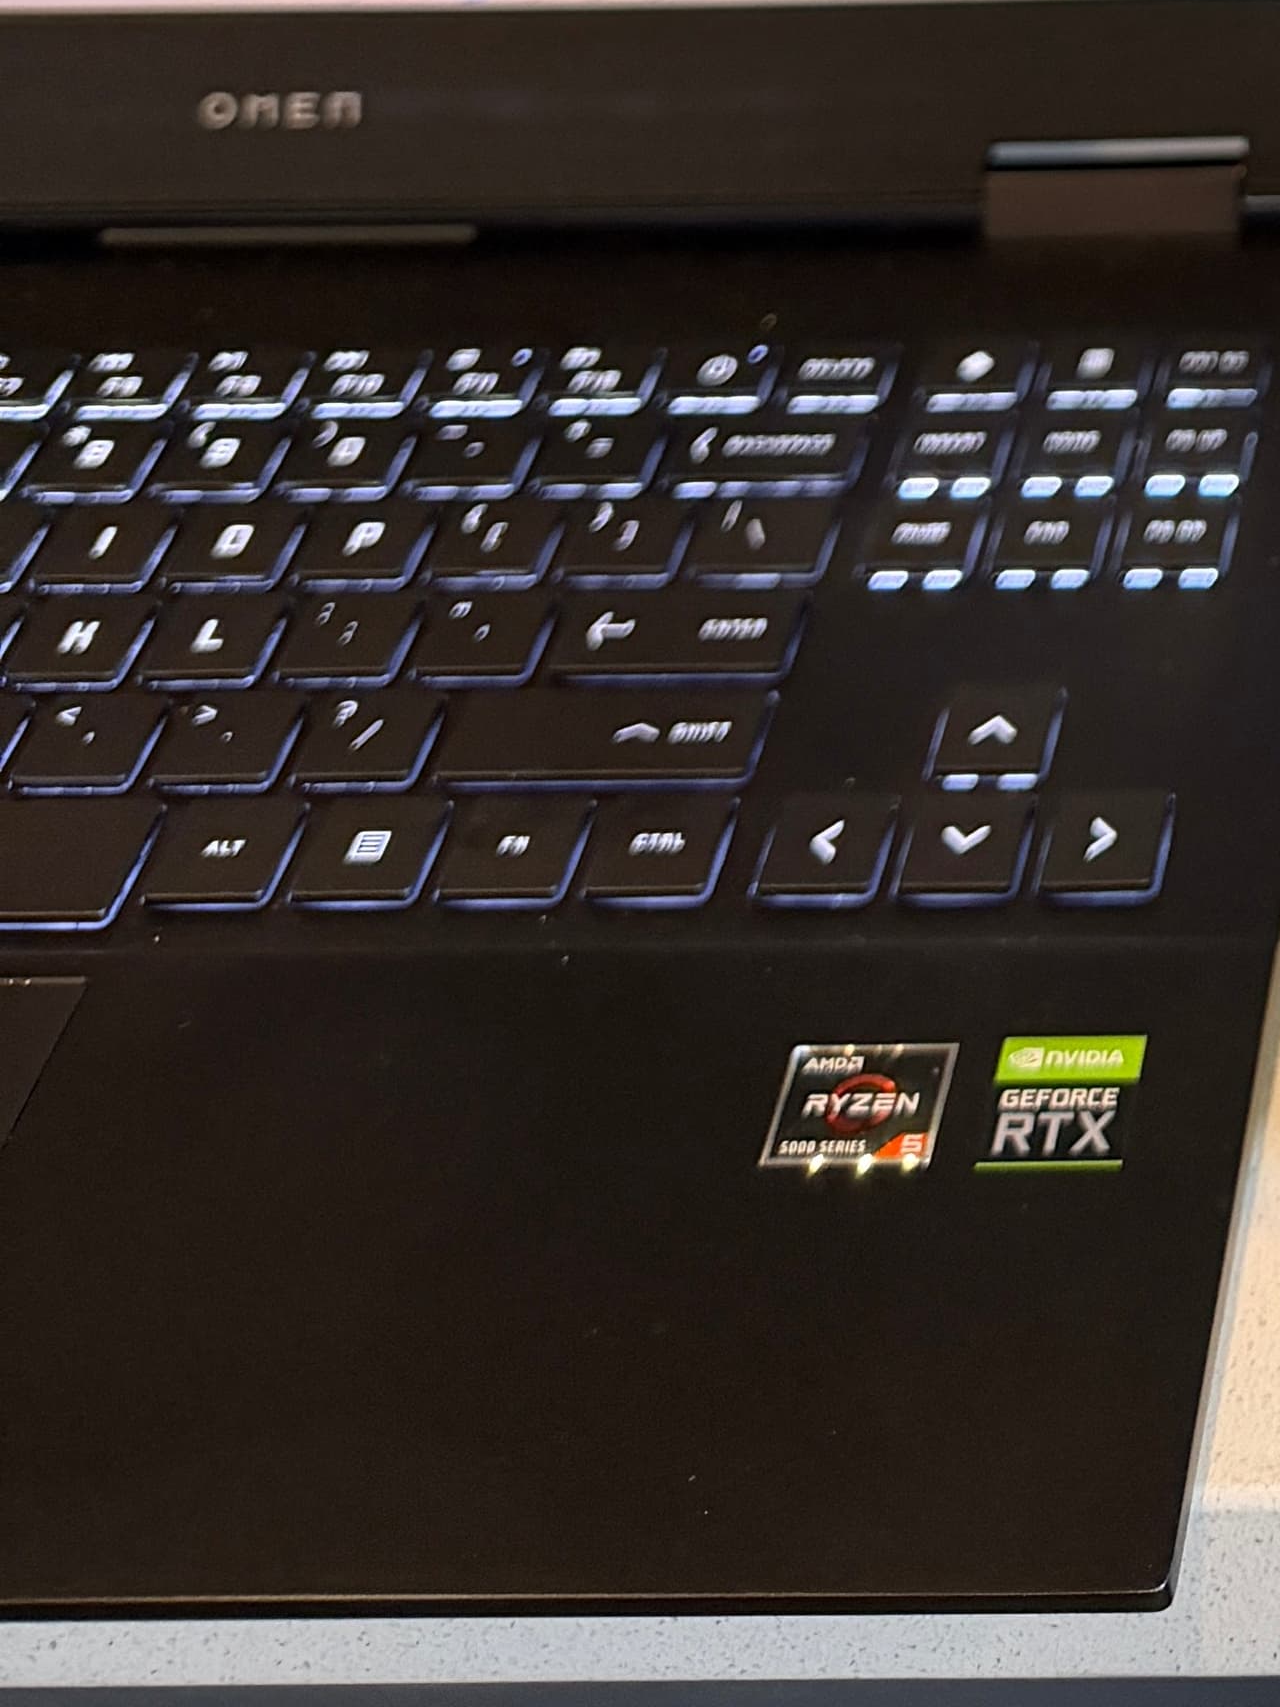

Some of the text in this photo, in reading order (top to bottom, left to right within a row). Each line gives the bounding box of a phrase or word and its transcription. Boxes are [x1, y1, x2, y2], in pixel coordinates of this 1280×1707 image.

[197, 91, 362, 129] OMEN
[190, 618, 224, 653] L
[200, 839, 247, 857] ALT
[1044, 1048, 1125, 1068] NVIDIA
[800, 1091, 920, 1118] RYZEN
[997, 1087, 1121, 1111] GEFORCE
[990, 1110, 1117, 1157] RTX
[818, 1138, 868, 1155] SERIES
